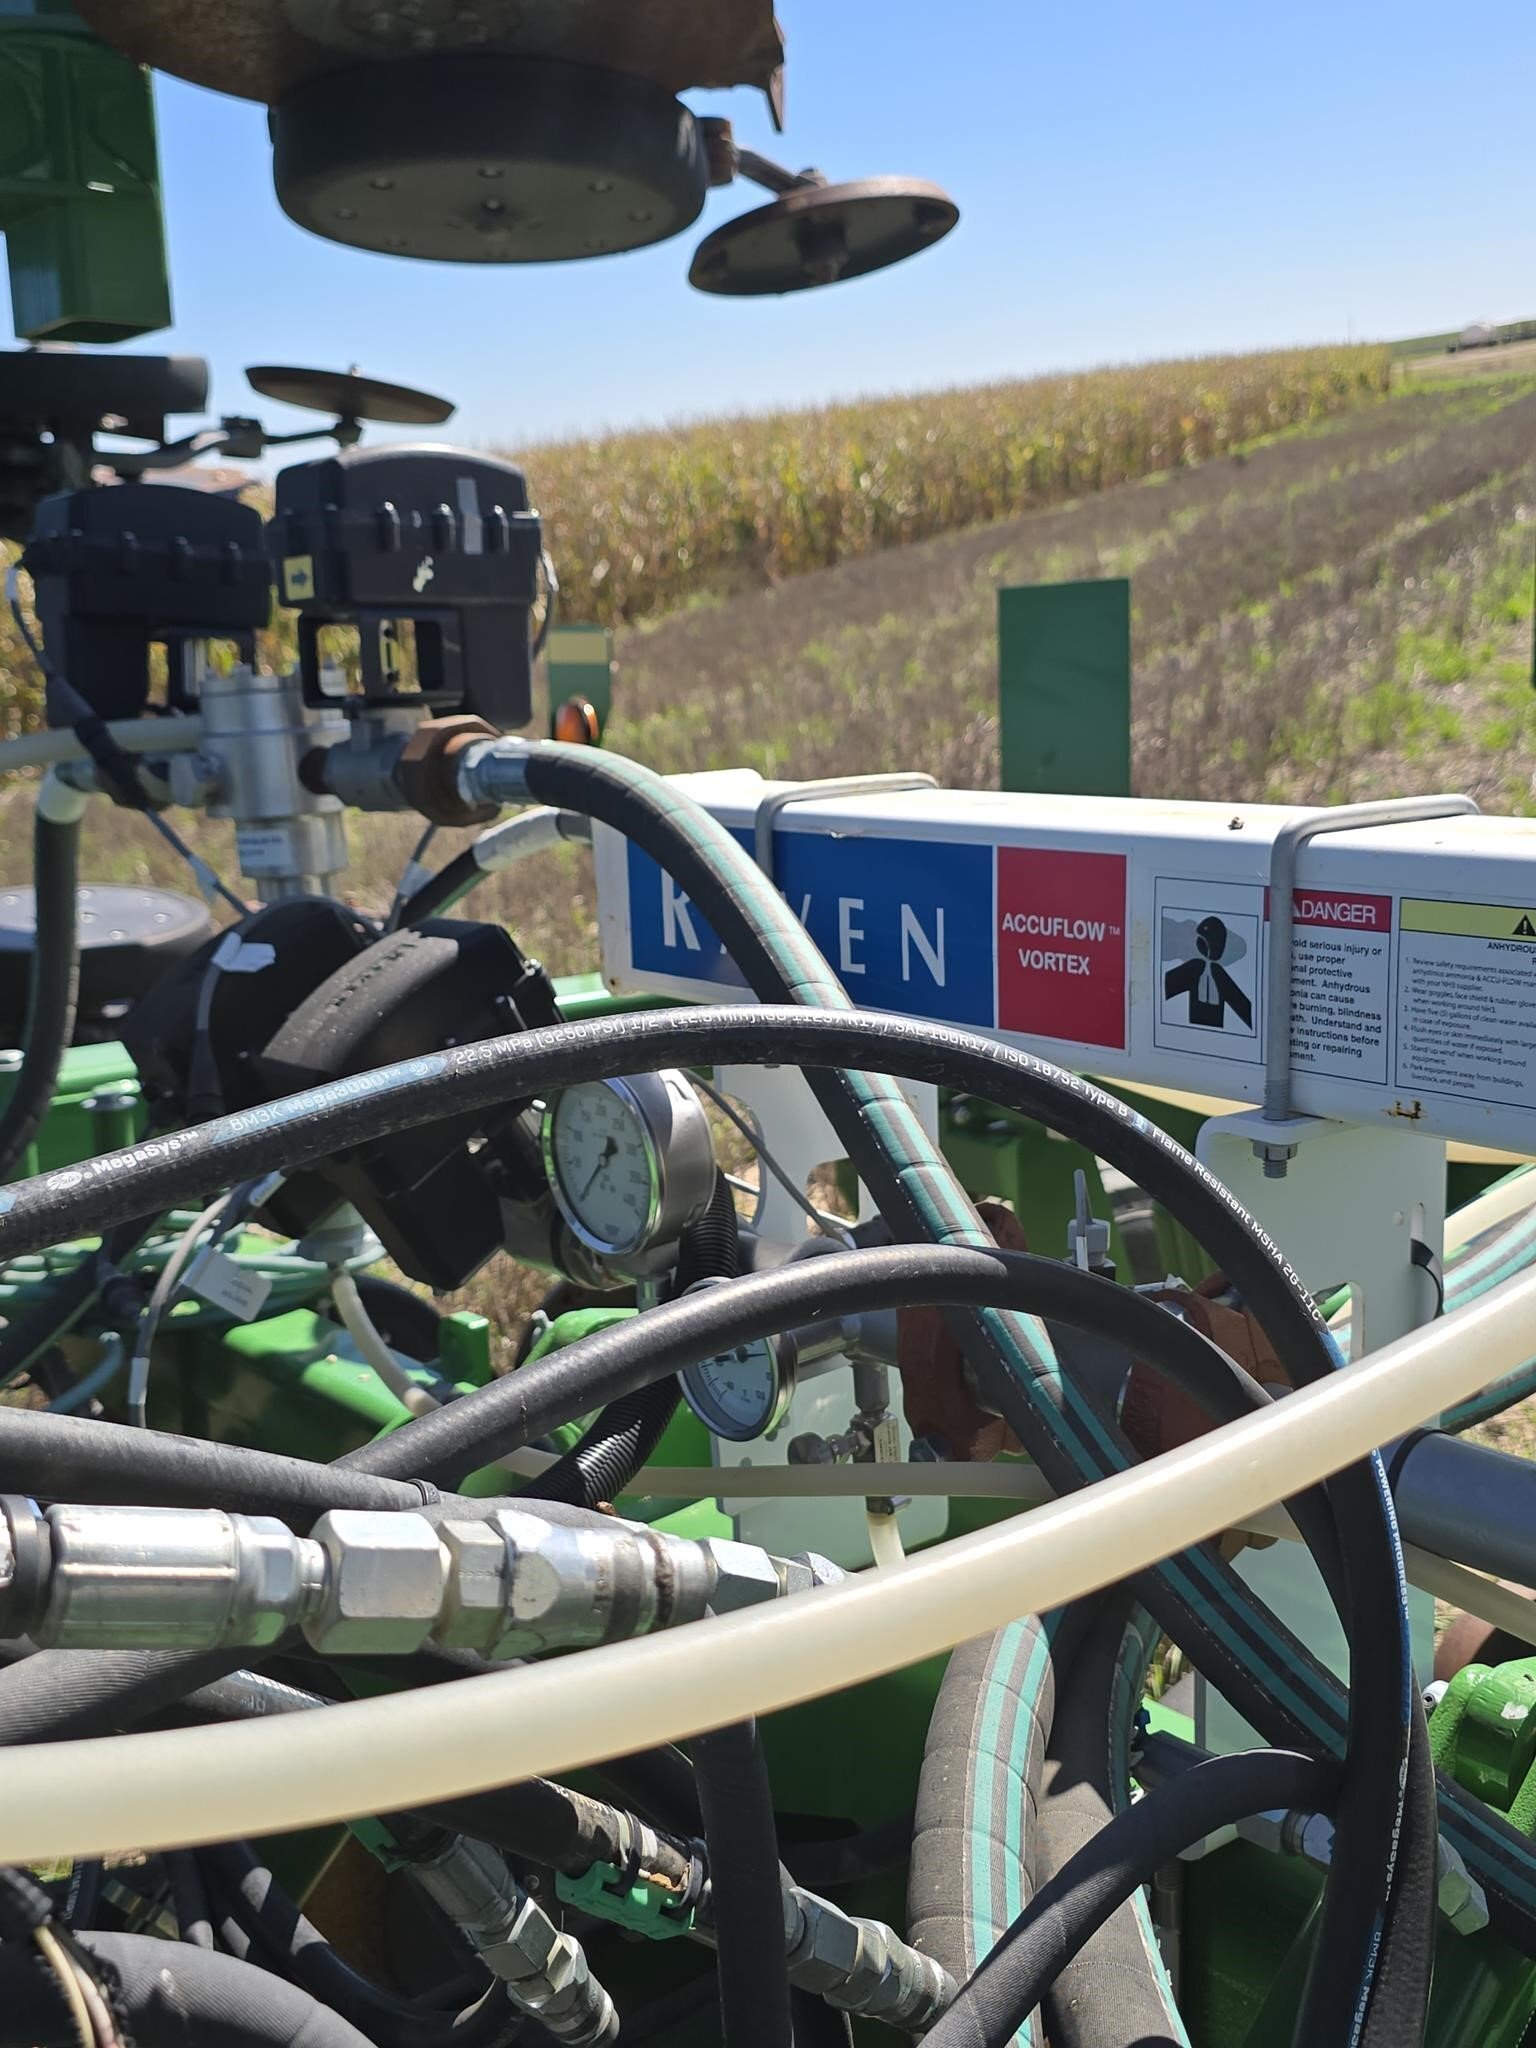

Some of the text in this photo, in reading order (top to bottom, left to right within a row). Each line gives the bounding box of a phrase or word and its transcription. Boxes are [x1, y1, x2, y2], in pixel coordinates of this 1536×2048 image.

[1302, 900, 1376, 925] DANGER
[661, 868, 945, 987] REN
[1291, 939, 1382, 956] oid serious injury or
[1487, 942, 1536, 954] ANHYDROU
[1018, 948, 1090, 976] VORTEX
[1299, 952, 1314, 960] use
[1316, 955, 1346, 965] proper
[1309, 966, 1353, 978] protective
[1322, 980, 1370, 993] Anhydrous
[1290, 989, 1355, 1004] onia can cause
[1338, 1007, 1382, 1020] blindness
[1312, 1016, 1362, 1030] Understand
[1364, 1024, 1381, 1033] and
[1297, 1027, 1348, 1041] instructions
[1351, 1034, 1380, 1046] before
[1311, 1042, 1321, 1050] or
[1322, 1044, 1362, 1058] repairing
[455, 1046, 493, 1065] 22.5
[494, 1036, 533, 1054] MPa
[535, 1025, 587, 1048] [3250
[588, 1018, 626, 1035] PSI]
[895, 1020, 925, 1036] SAE
[929, 1025, 989, 1052] 100R17
[993, 1044, 1001, 1058] /
[1004, 1048, 1029, 1066] ISO
[1032, 1061, 1081, 1090] 18752
[1081, 1083, 1116, 1109] Type
[1117, 1102, 1128, 1117] B
[1152, 1125, 1194, 1166] Flame
[1193, 1160, 1252, 1225] Resistant
[1251, 1218, 1284, 1265] MSHA
[1282, 1262, 1322, 1322] 2G-11C
[1375, 1458, 1397, 1530] POWERING
[1349, 1985, 1371, 2048] Mega3
